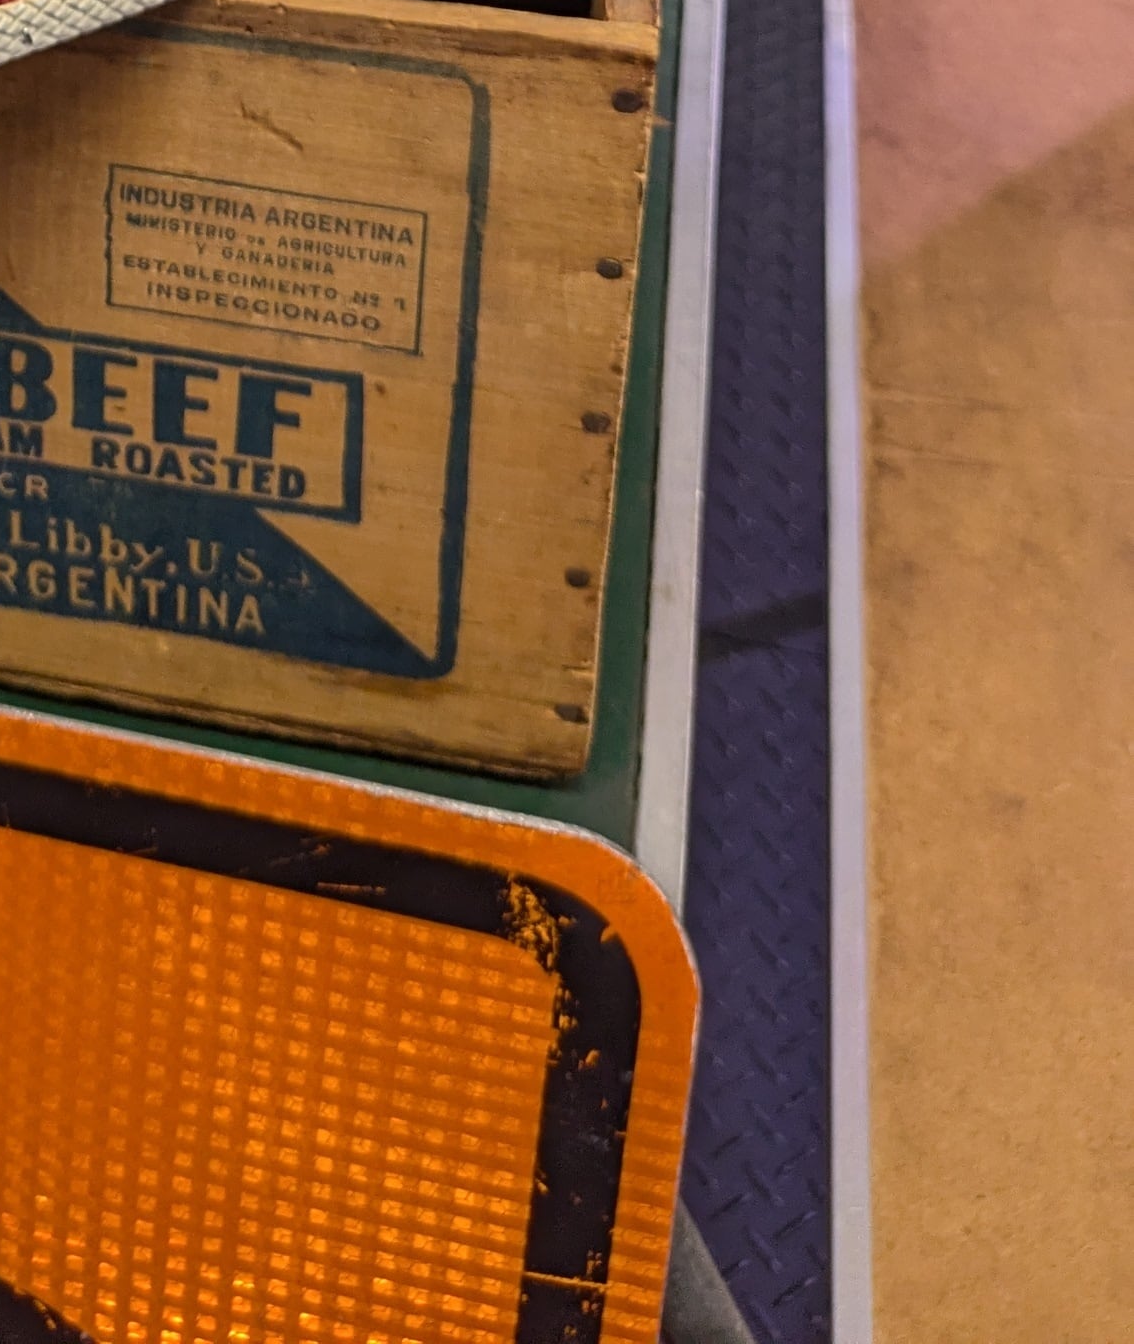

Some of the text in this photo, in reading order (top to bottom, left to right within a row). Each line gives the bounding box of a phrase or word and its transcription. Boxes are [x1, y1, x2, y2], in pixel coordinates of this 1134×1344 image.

[119, 182, 414, 246] INDUSTRIA ARGENTINA
[124, 212, 237, 241] MINISTERIO
[277, 235, 407, 268] AGRICULTURA
[122, 253, 338, 300] ESTABLECIMIENTO
[195, 241, 335, 276] Y GANADERIA
[146, 281, 381, 332] INSPECCIONADO
[91, 436, 306, 500] ROASTED
